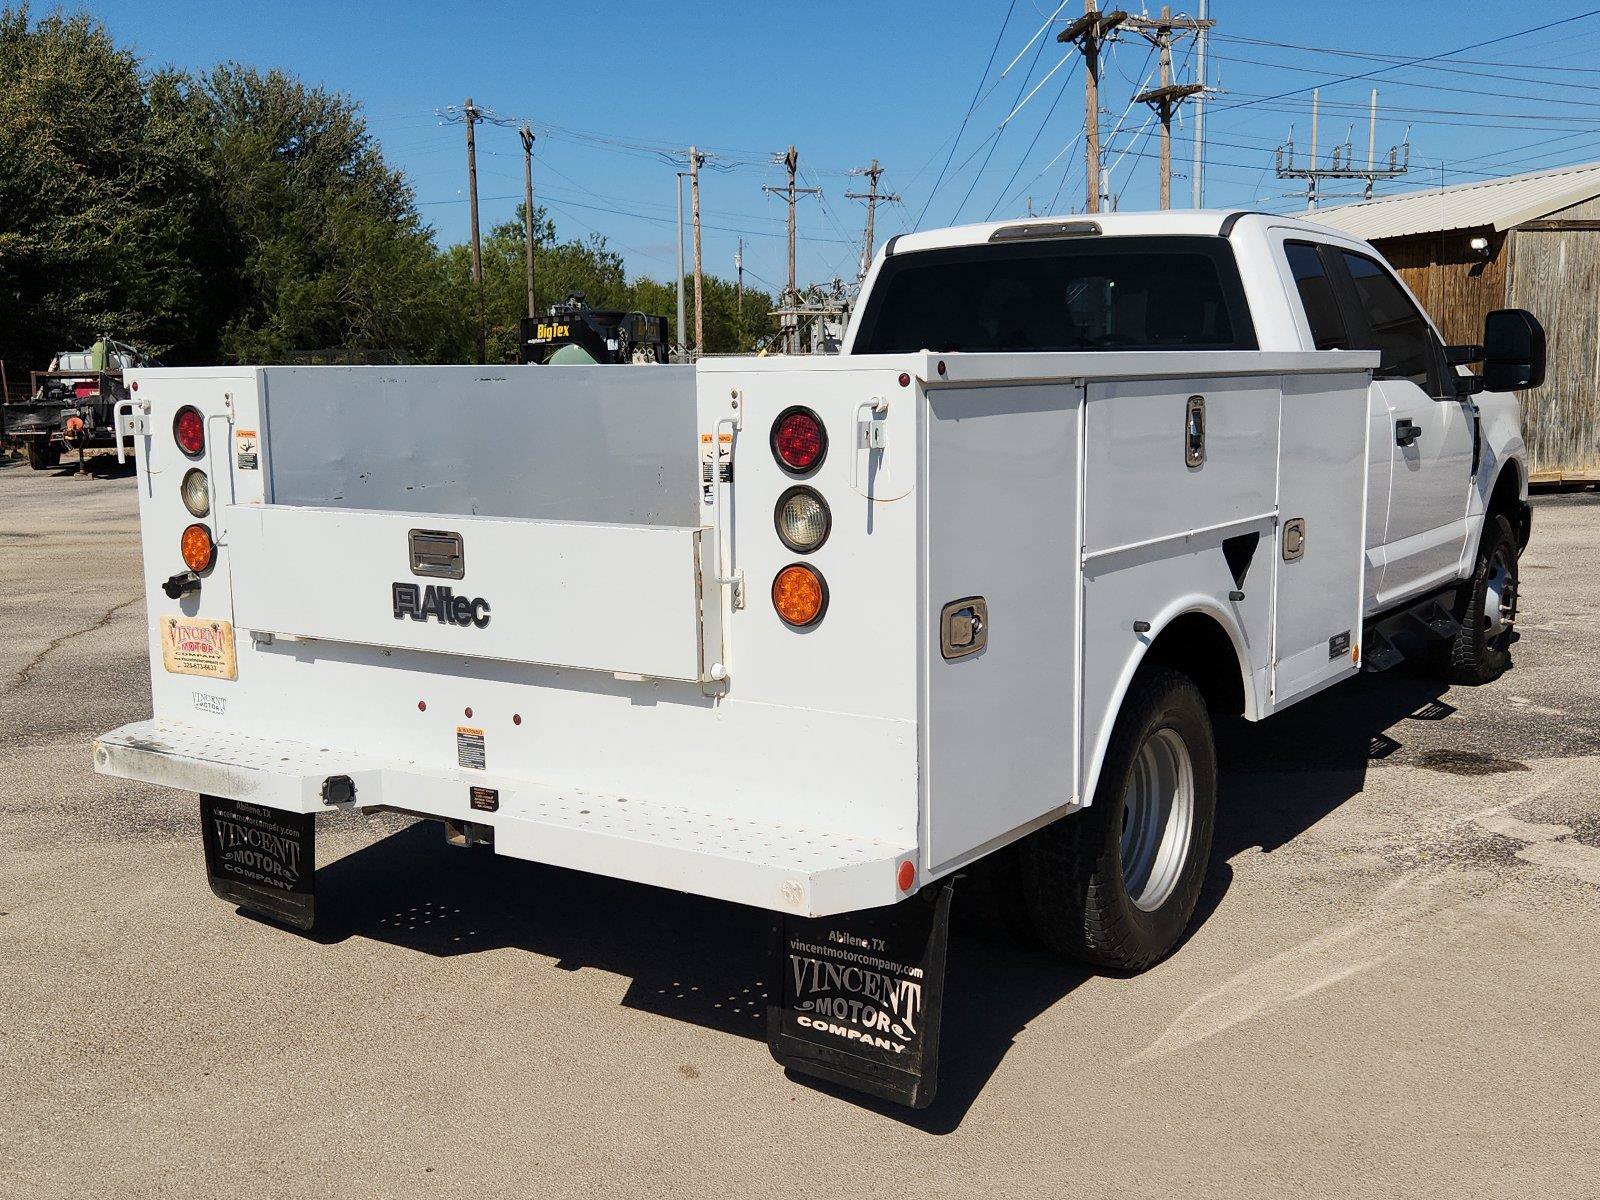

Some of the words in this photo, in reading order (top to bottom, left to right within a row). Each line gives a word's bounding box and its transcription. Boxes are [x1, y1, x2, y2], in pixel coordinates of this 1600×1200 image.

[537, 322, 569, 341] BigTex
[421, 585, 491, 629] Altec
[168, 625, 225, 654] VINCENT
[182, 641, 214, 653] MOTOR
[214, 819, 300, 877] VINCENT
[233, 850, 282, 876] MOTOR
[224, 863, 294, 891] COMPANY
[828, 930, 870, 951] Abilene,
[872, 938, 886, 952] TX
[790, 939, 924, 979] vincentmotorcompany.com
[789, 955, 922, 1035] VINCENT
[815, 997, 891, 1033] MOTOR
[797, 1016, 906, 1054] COMPANY
